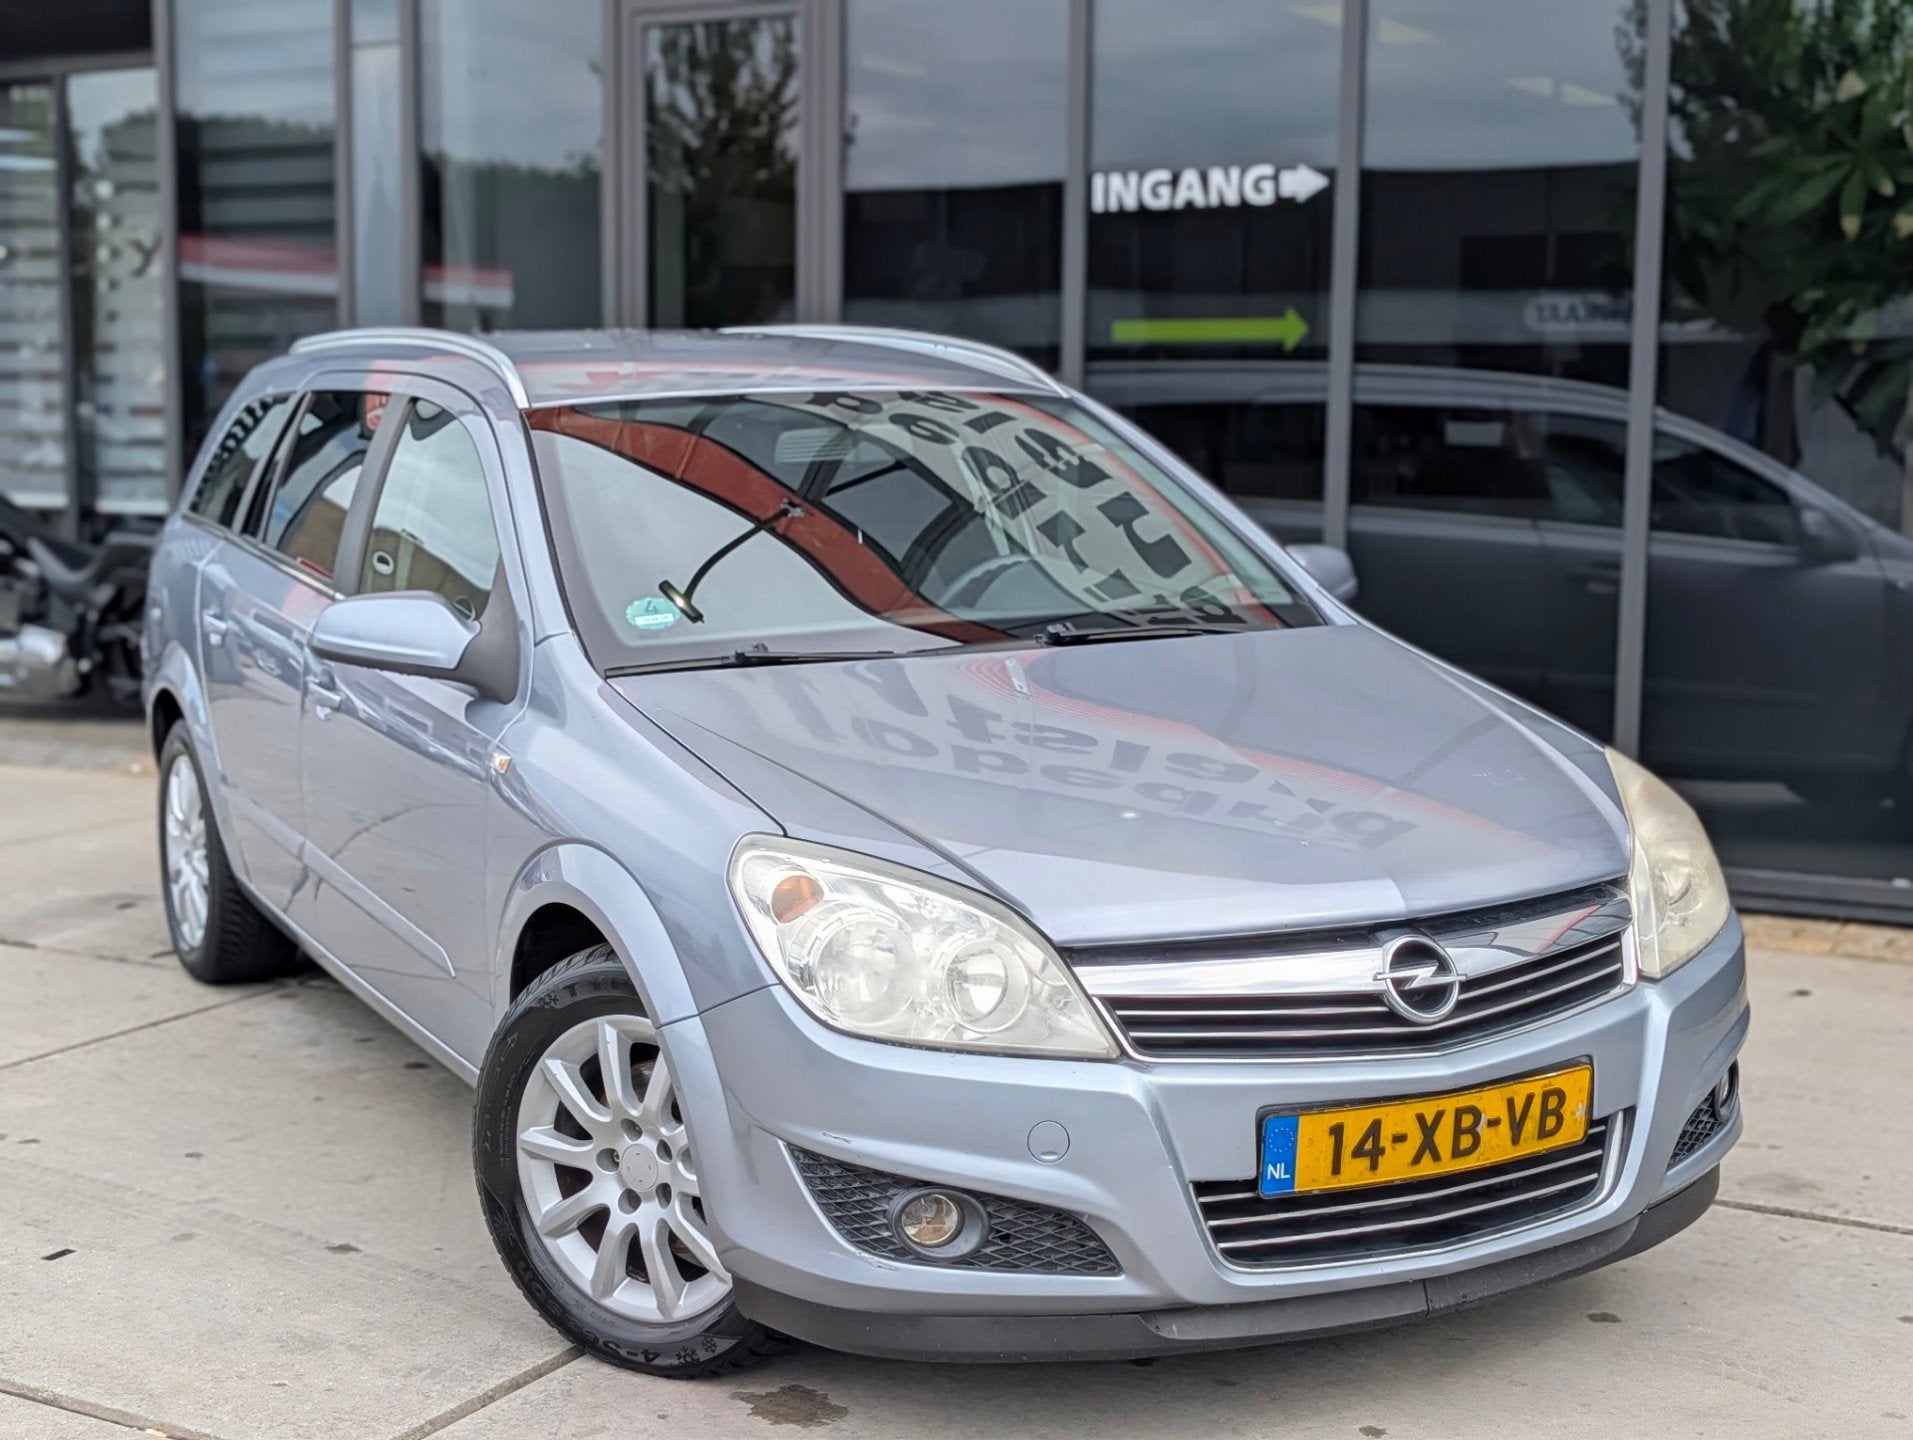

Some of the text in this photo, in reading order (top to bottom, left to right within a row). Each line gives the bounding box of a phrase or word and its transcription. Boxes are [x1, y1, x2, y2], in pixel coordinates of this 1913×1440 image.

[1091, 163, 1276, 213] INGANG
[1328, 1087, 1567, 1176] 14-XB-VB
[1267, 1163, 1290, 1180] NL
